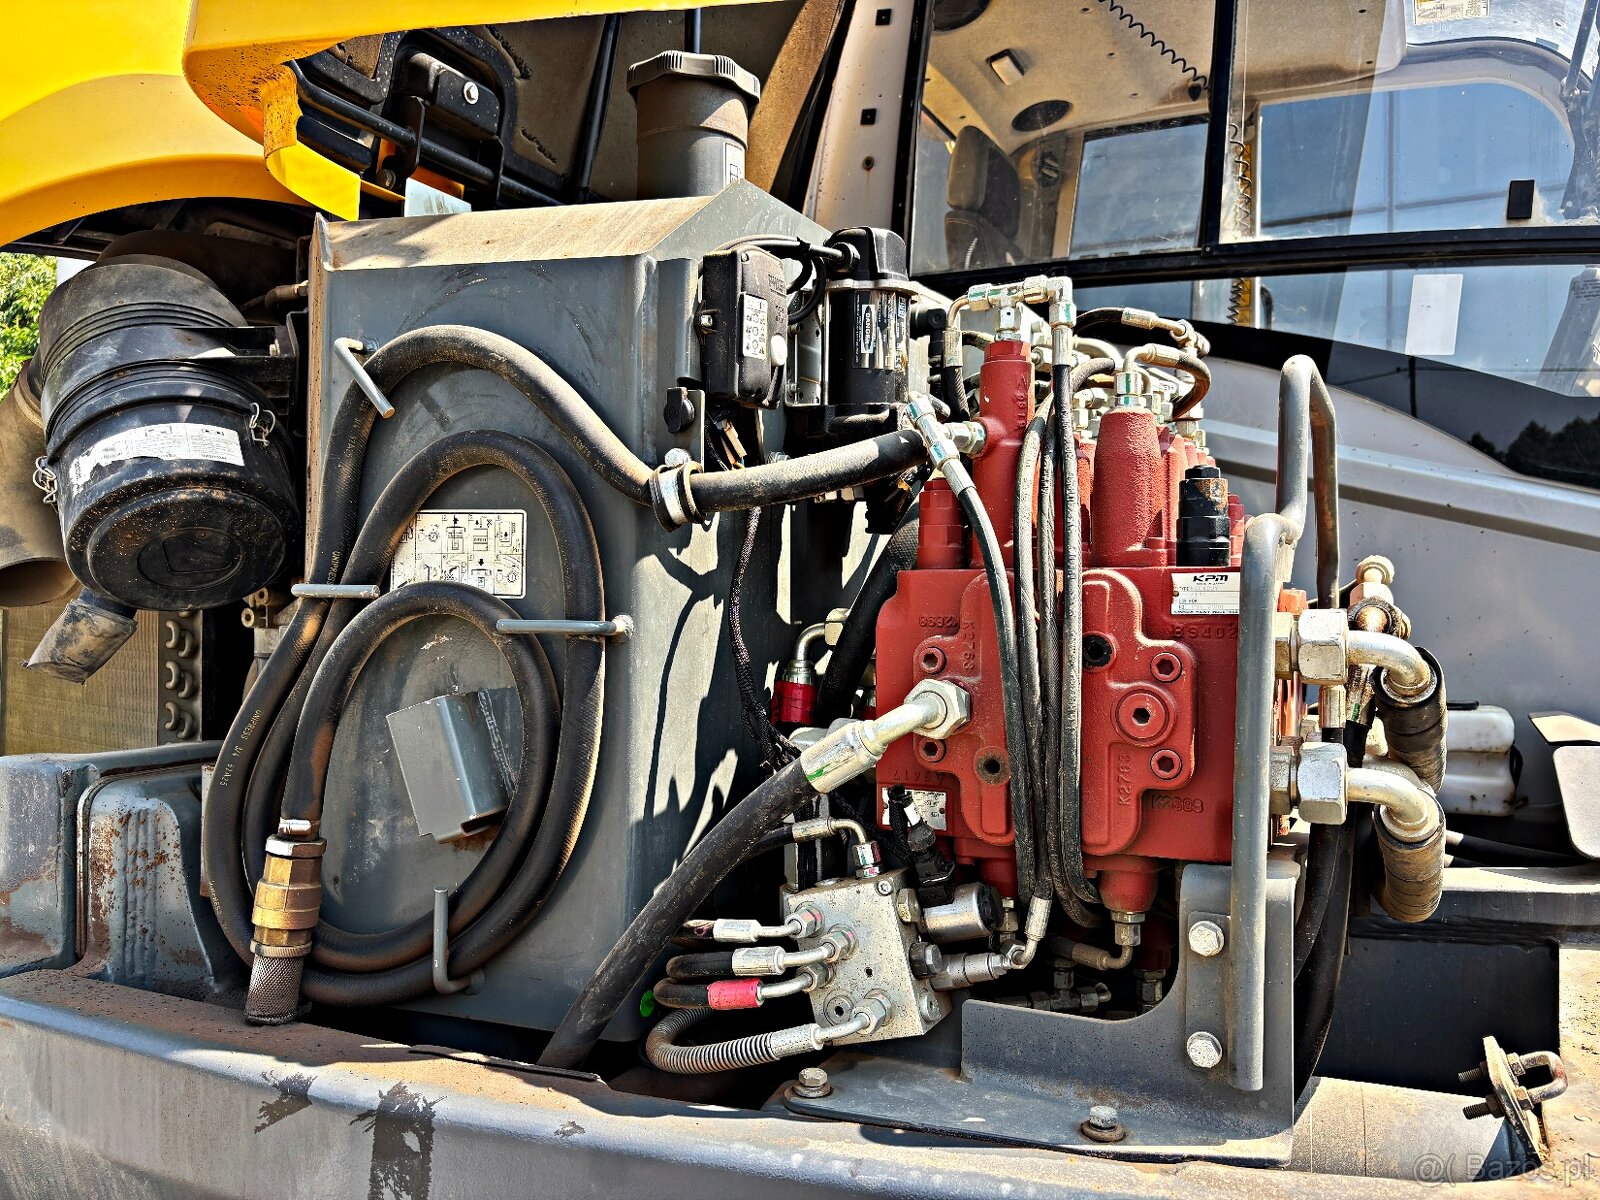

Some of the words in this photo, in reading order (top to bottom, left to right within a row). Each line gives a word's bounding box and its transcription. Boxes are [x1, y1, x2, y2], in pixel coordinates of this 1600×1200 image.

[326, 550, 341, 585] UNIPRESS
[1193, 574, 1229, 582] KPM
[240, 708, 264, 740] UNIPRESS
[231, 745, 243, 757] 3/4
